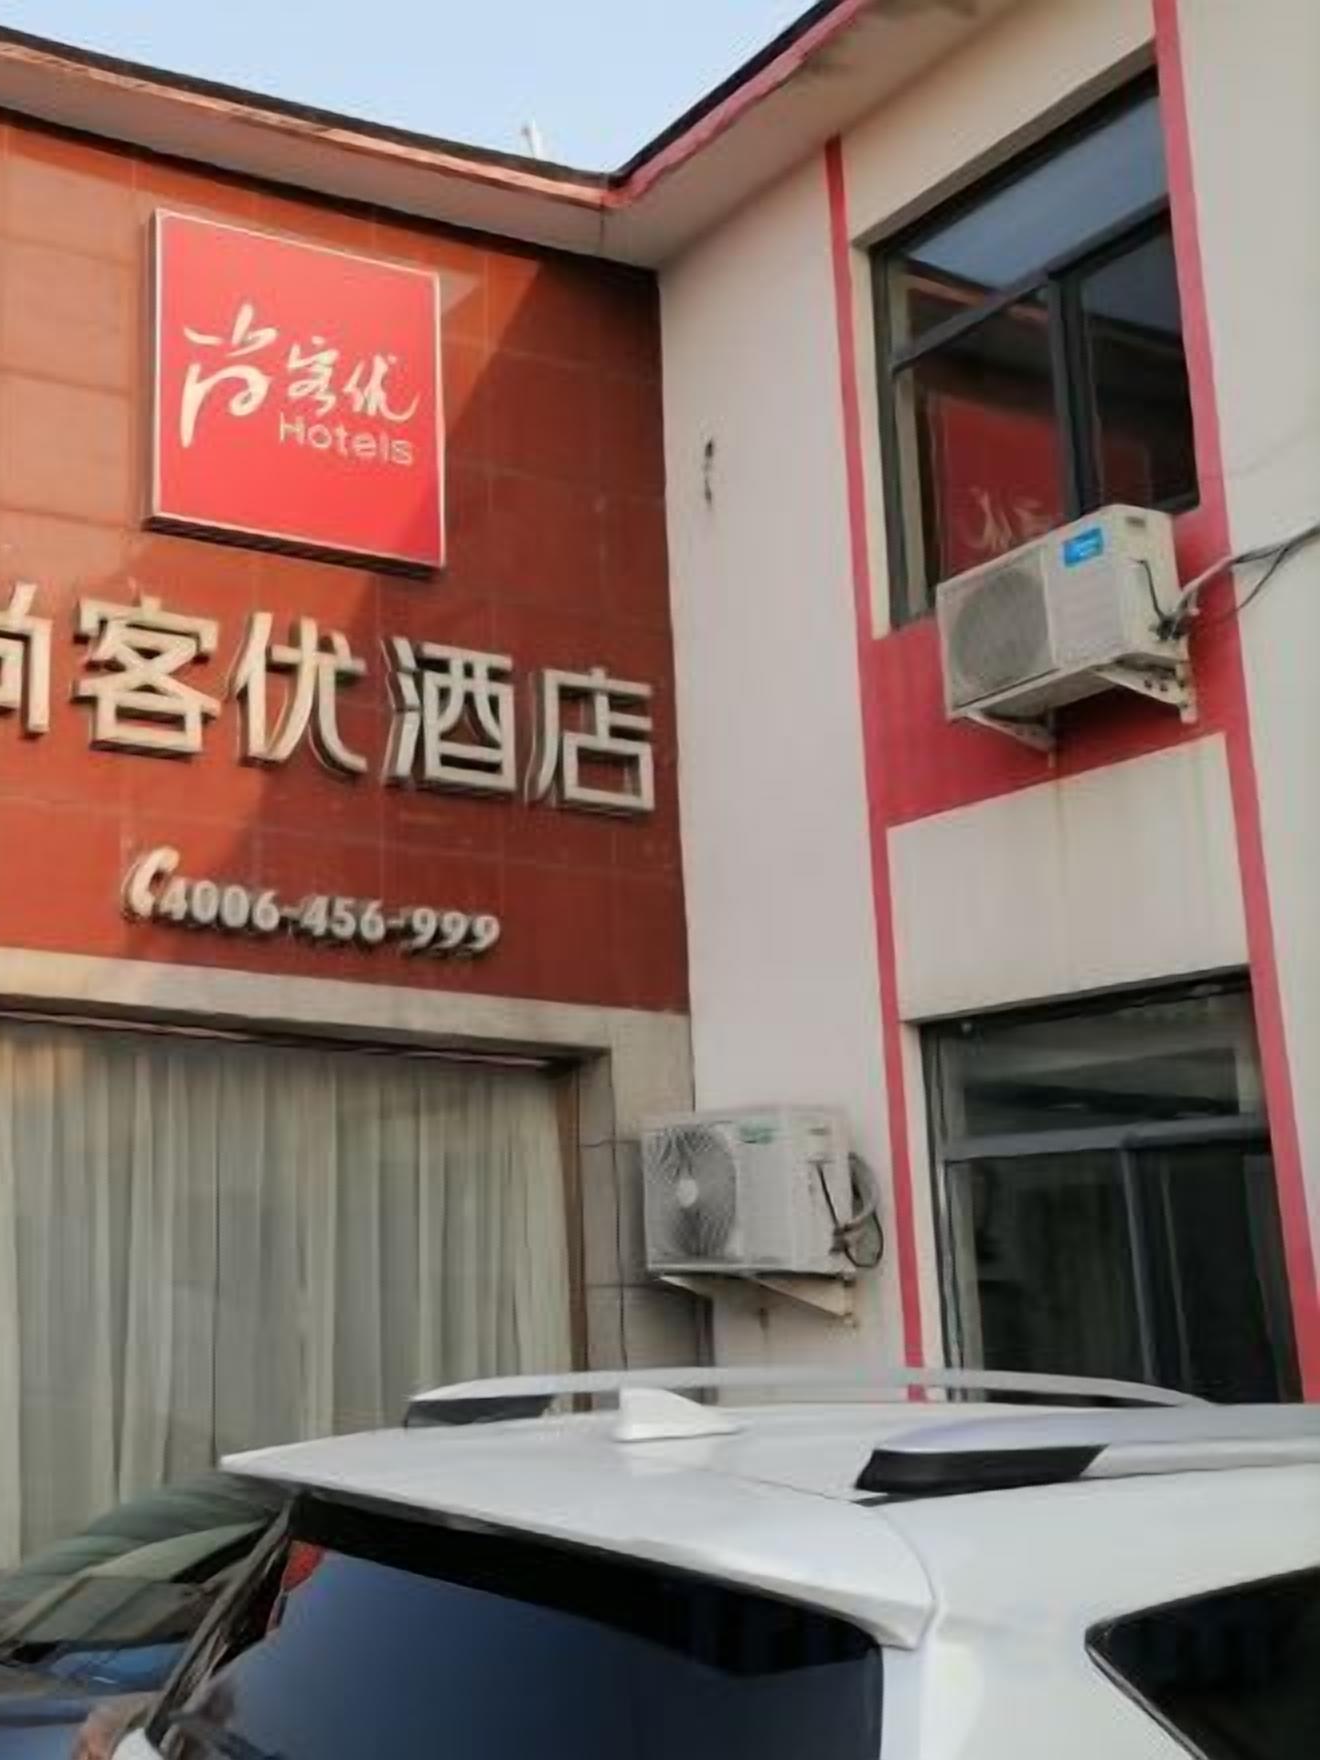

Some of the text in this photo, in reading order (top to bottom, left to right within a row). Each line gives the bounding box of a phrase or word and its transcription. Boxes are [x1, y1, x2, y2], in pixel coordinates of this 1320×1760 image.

[181, 302, 421, 447] 尚客优
[279, 411, 414, 466] Hotels
[160, 876, 501, 952] 4006-456-999
